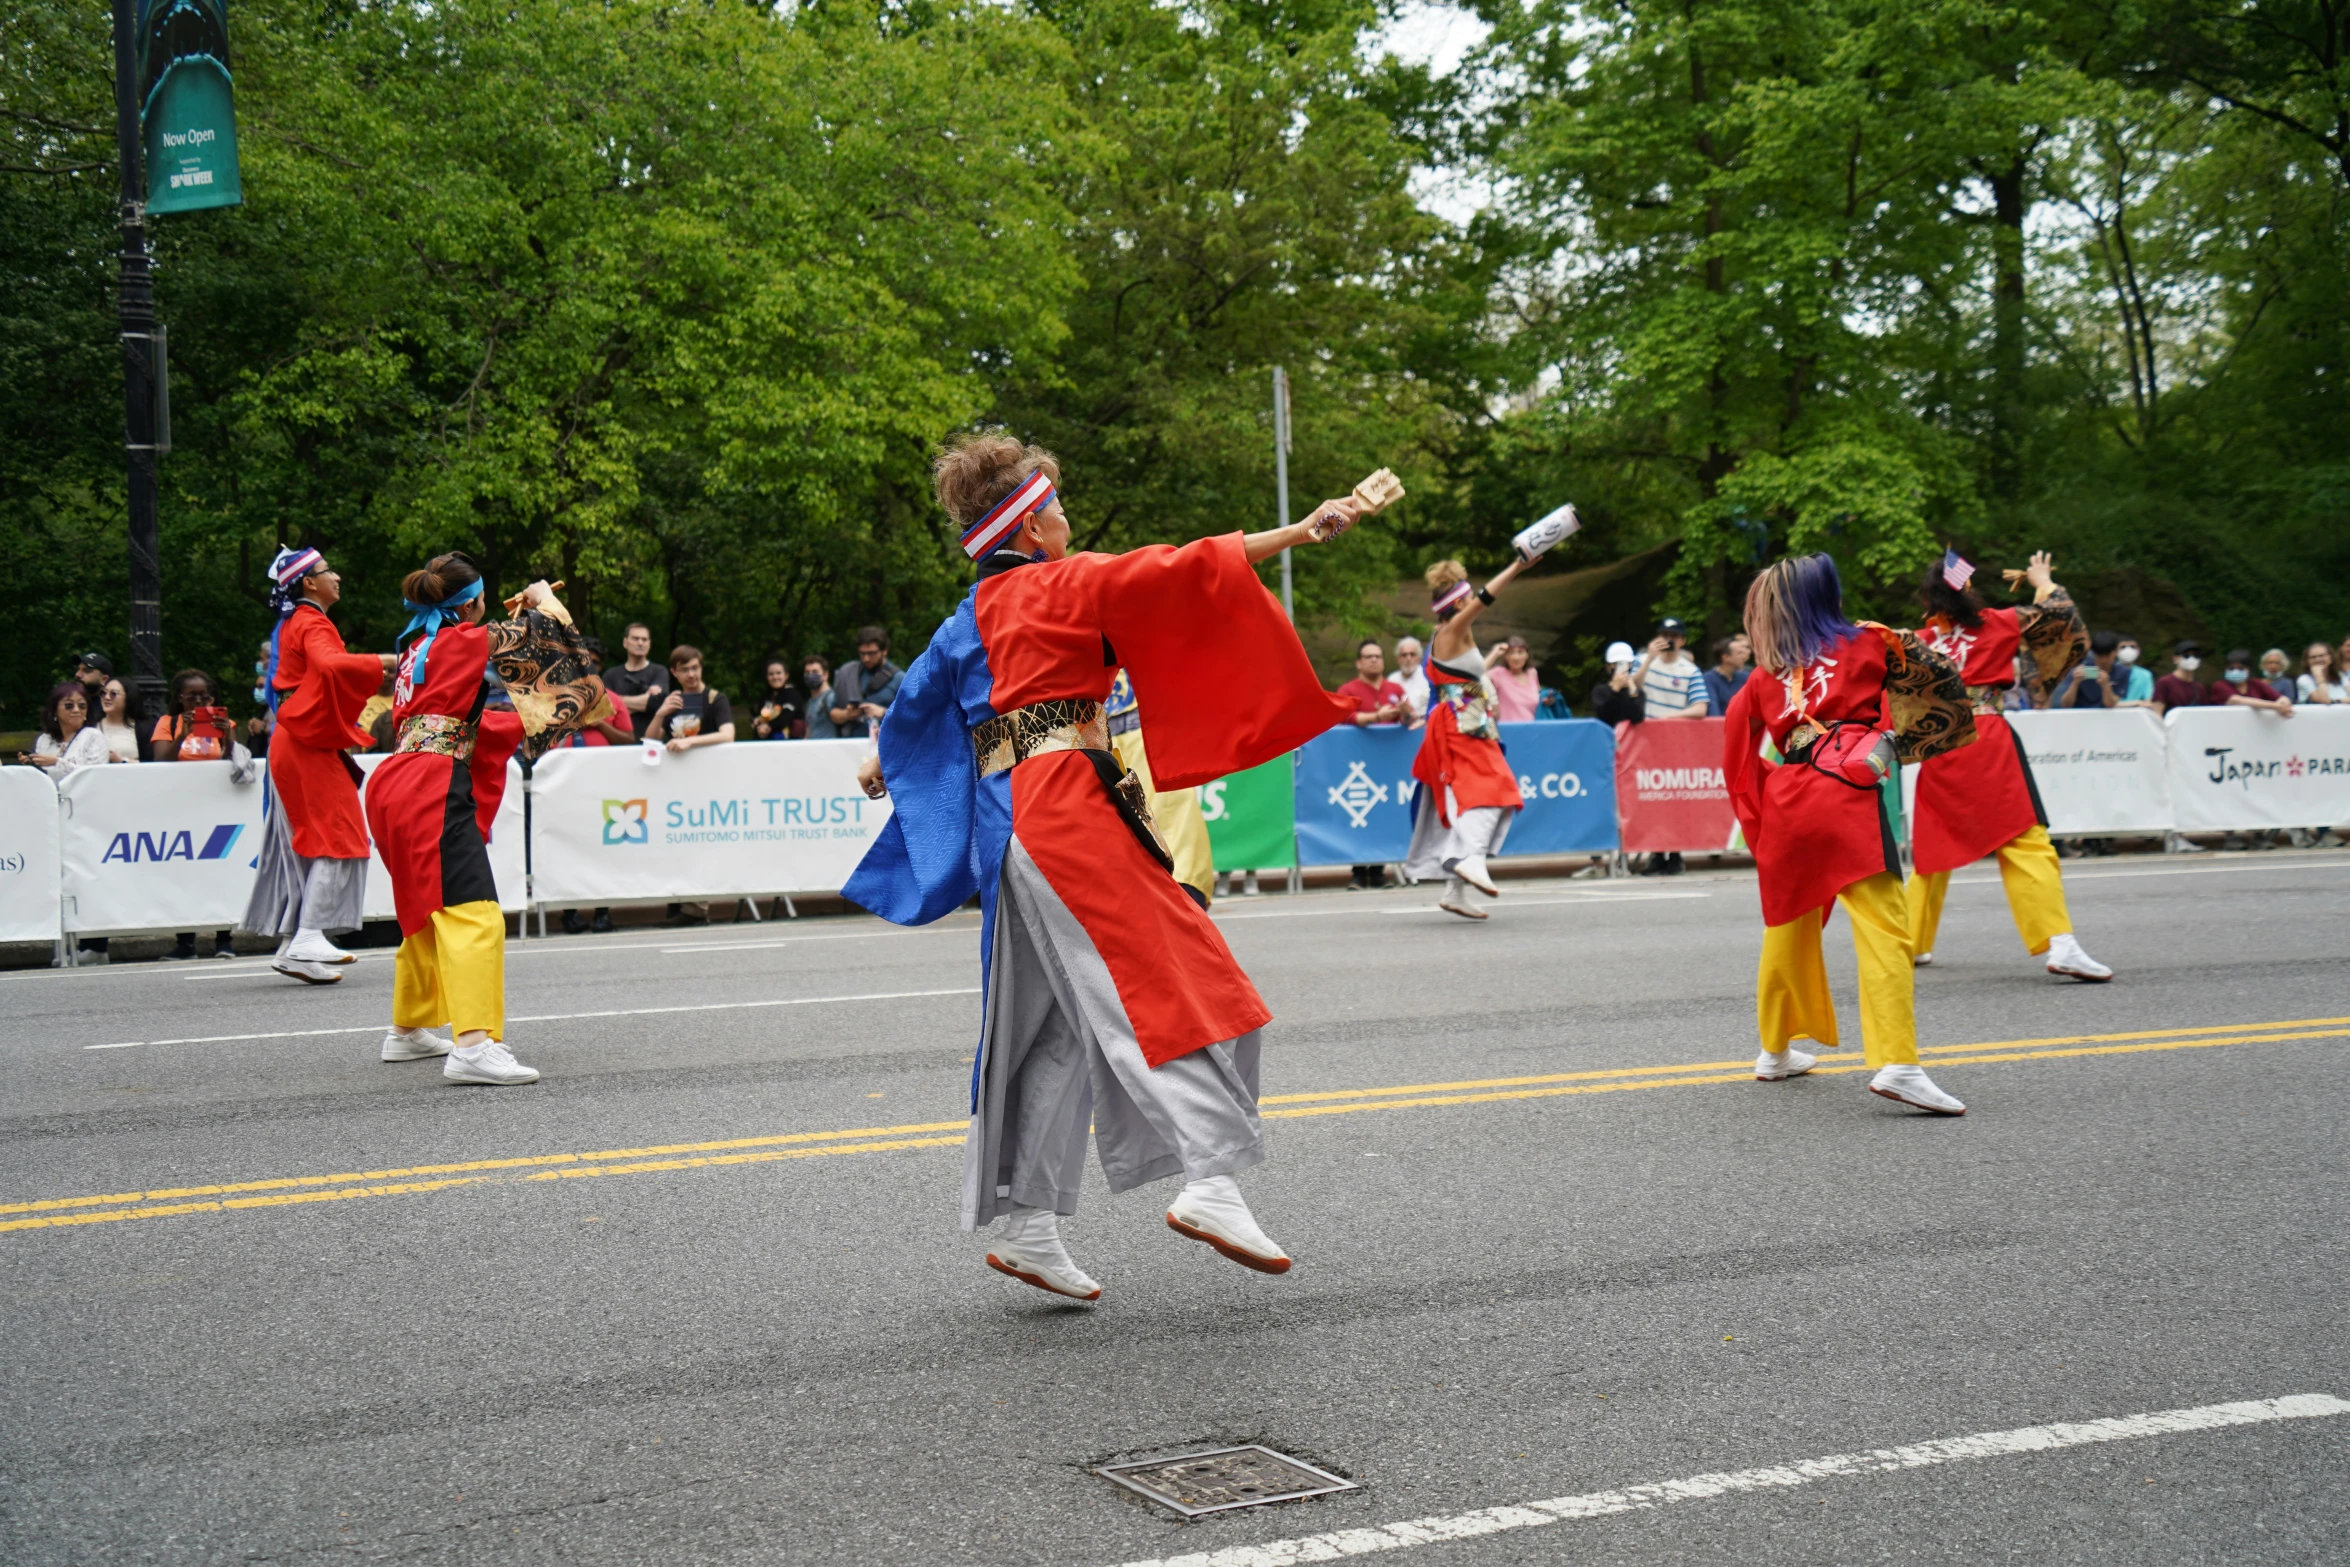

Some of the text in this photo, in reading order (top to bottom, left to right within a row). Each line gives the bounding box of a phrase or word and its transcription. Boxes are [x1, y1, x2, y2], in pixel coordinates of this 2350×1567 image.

[163, 129, 215, 148] Now Open
[2026, 748, 2137, 765] oration of Americas
[1636, 768, 1727, 790] NOMURA
[2204, 748, 2281, 791] Japan
[1541, 773, 1587, 798] CO.
[665, 797, 868, 828] SuMi TRUST
[101, 830, 194, 863] ANA
[665, 827, 868, 844] SUMITOMO MITSUI TRUST BANK
